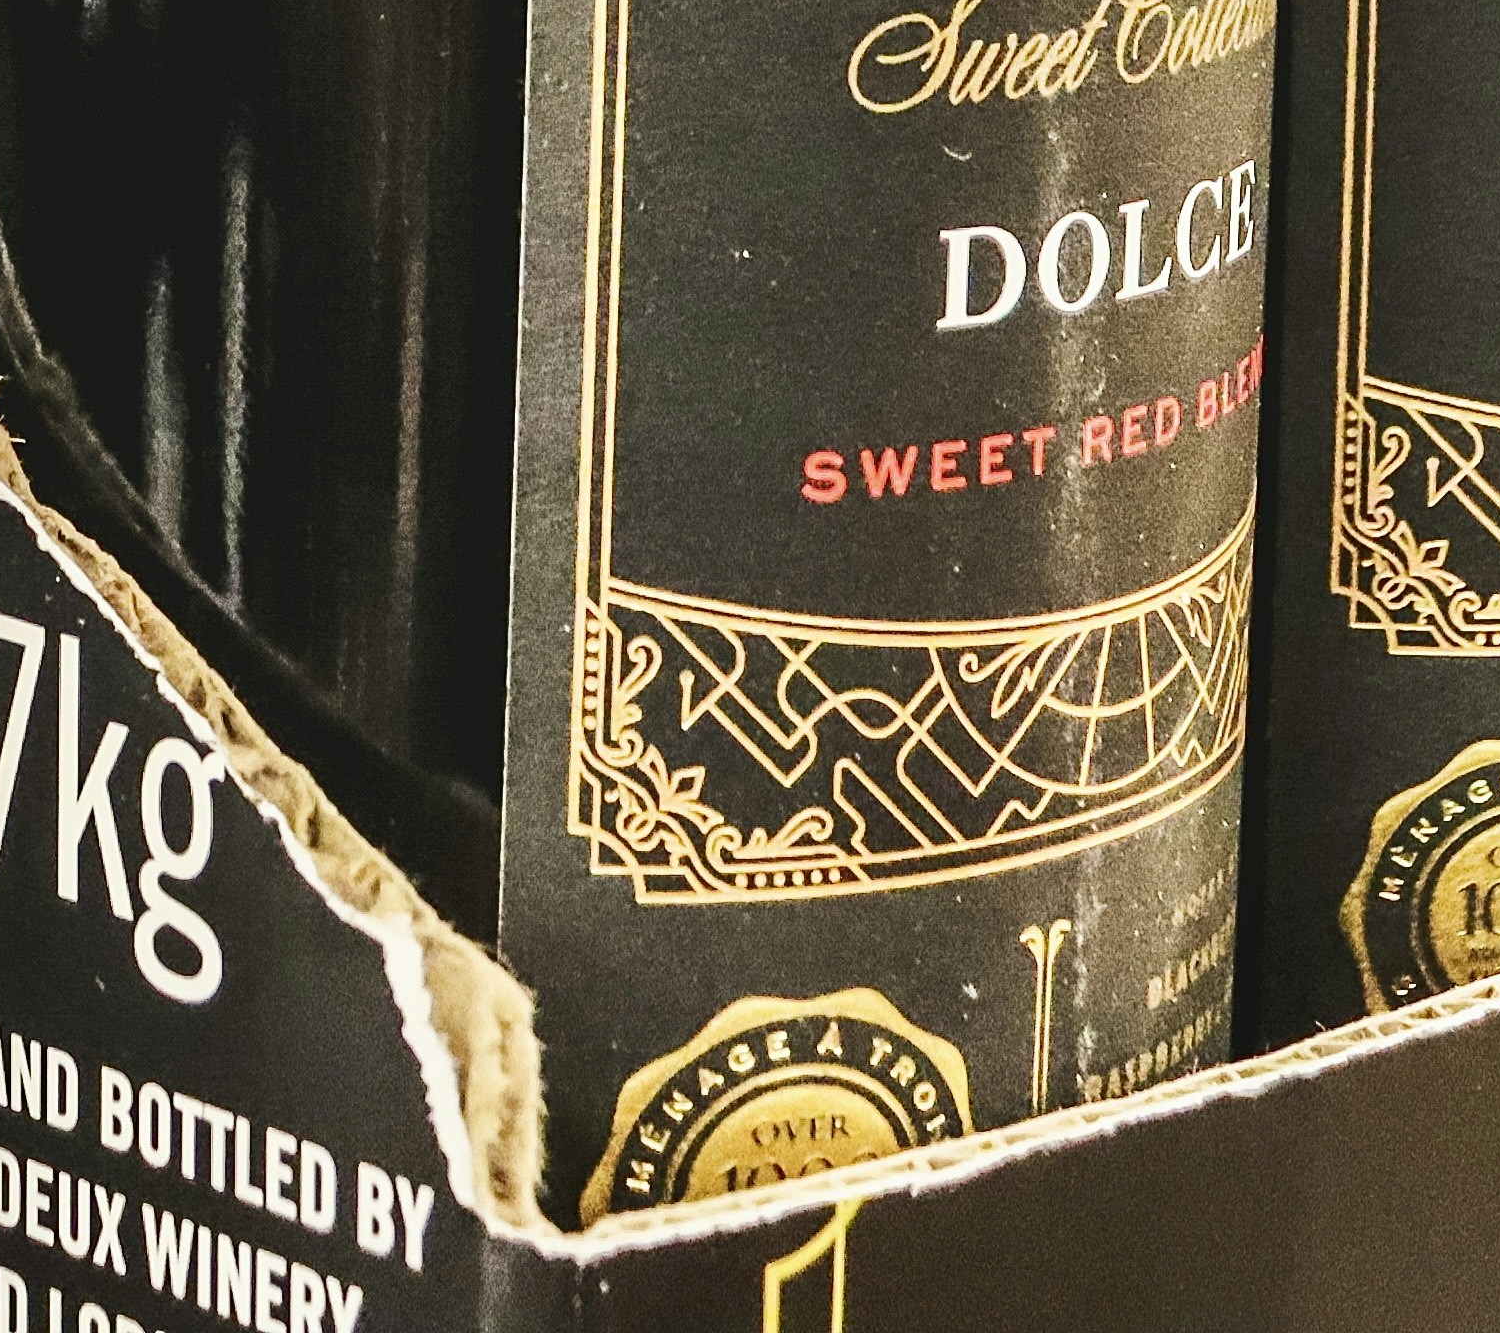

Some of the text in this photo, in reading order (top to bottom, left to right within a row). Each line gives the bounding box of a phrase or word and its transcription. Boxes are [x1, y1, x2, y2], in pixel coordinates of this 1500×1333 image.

[936, 160, 1257, 332] DOLCE
[801, 333, 1265, 504] SWEET RED BLEN
[750, 1114, 851, 1147] OVER
[868, 1036, 947, 1139] TROI
[100, 1064, 339, 1234] BOTTLED
[355, 1160, 436, 1274] BY
[140, 1201, 365, 1333] WINERY
